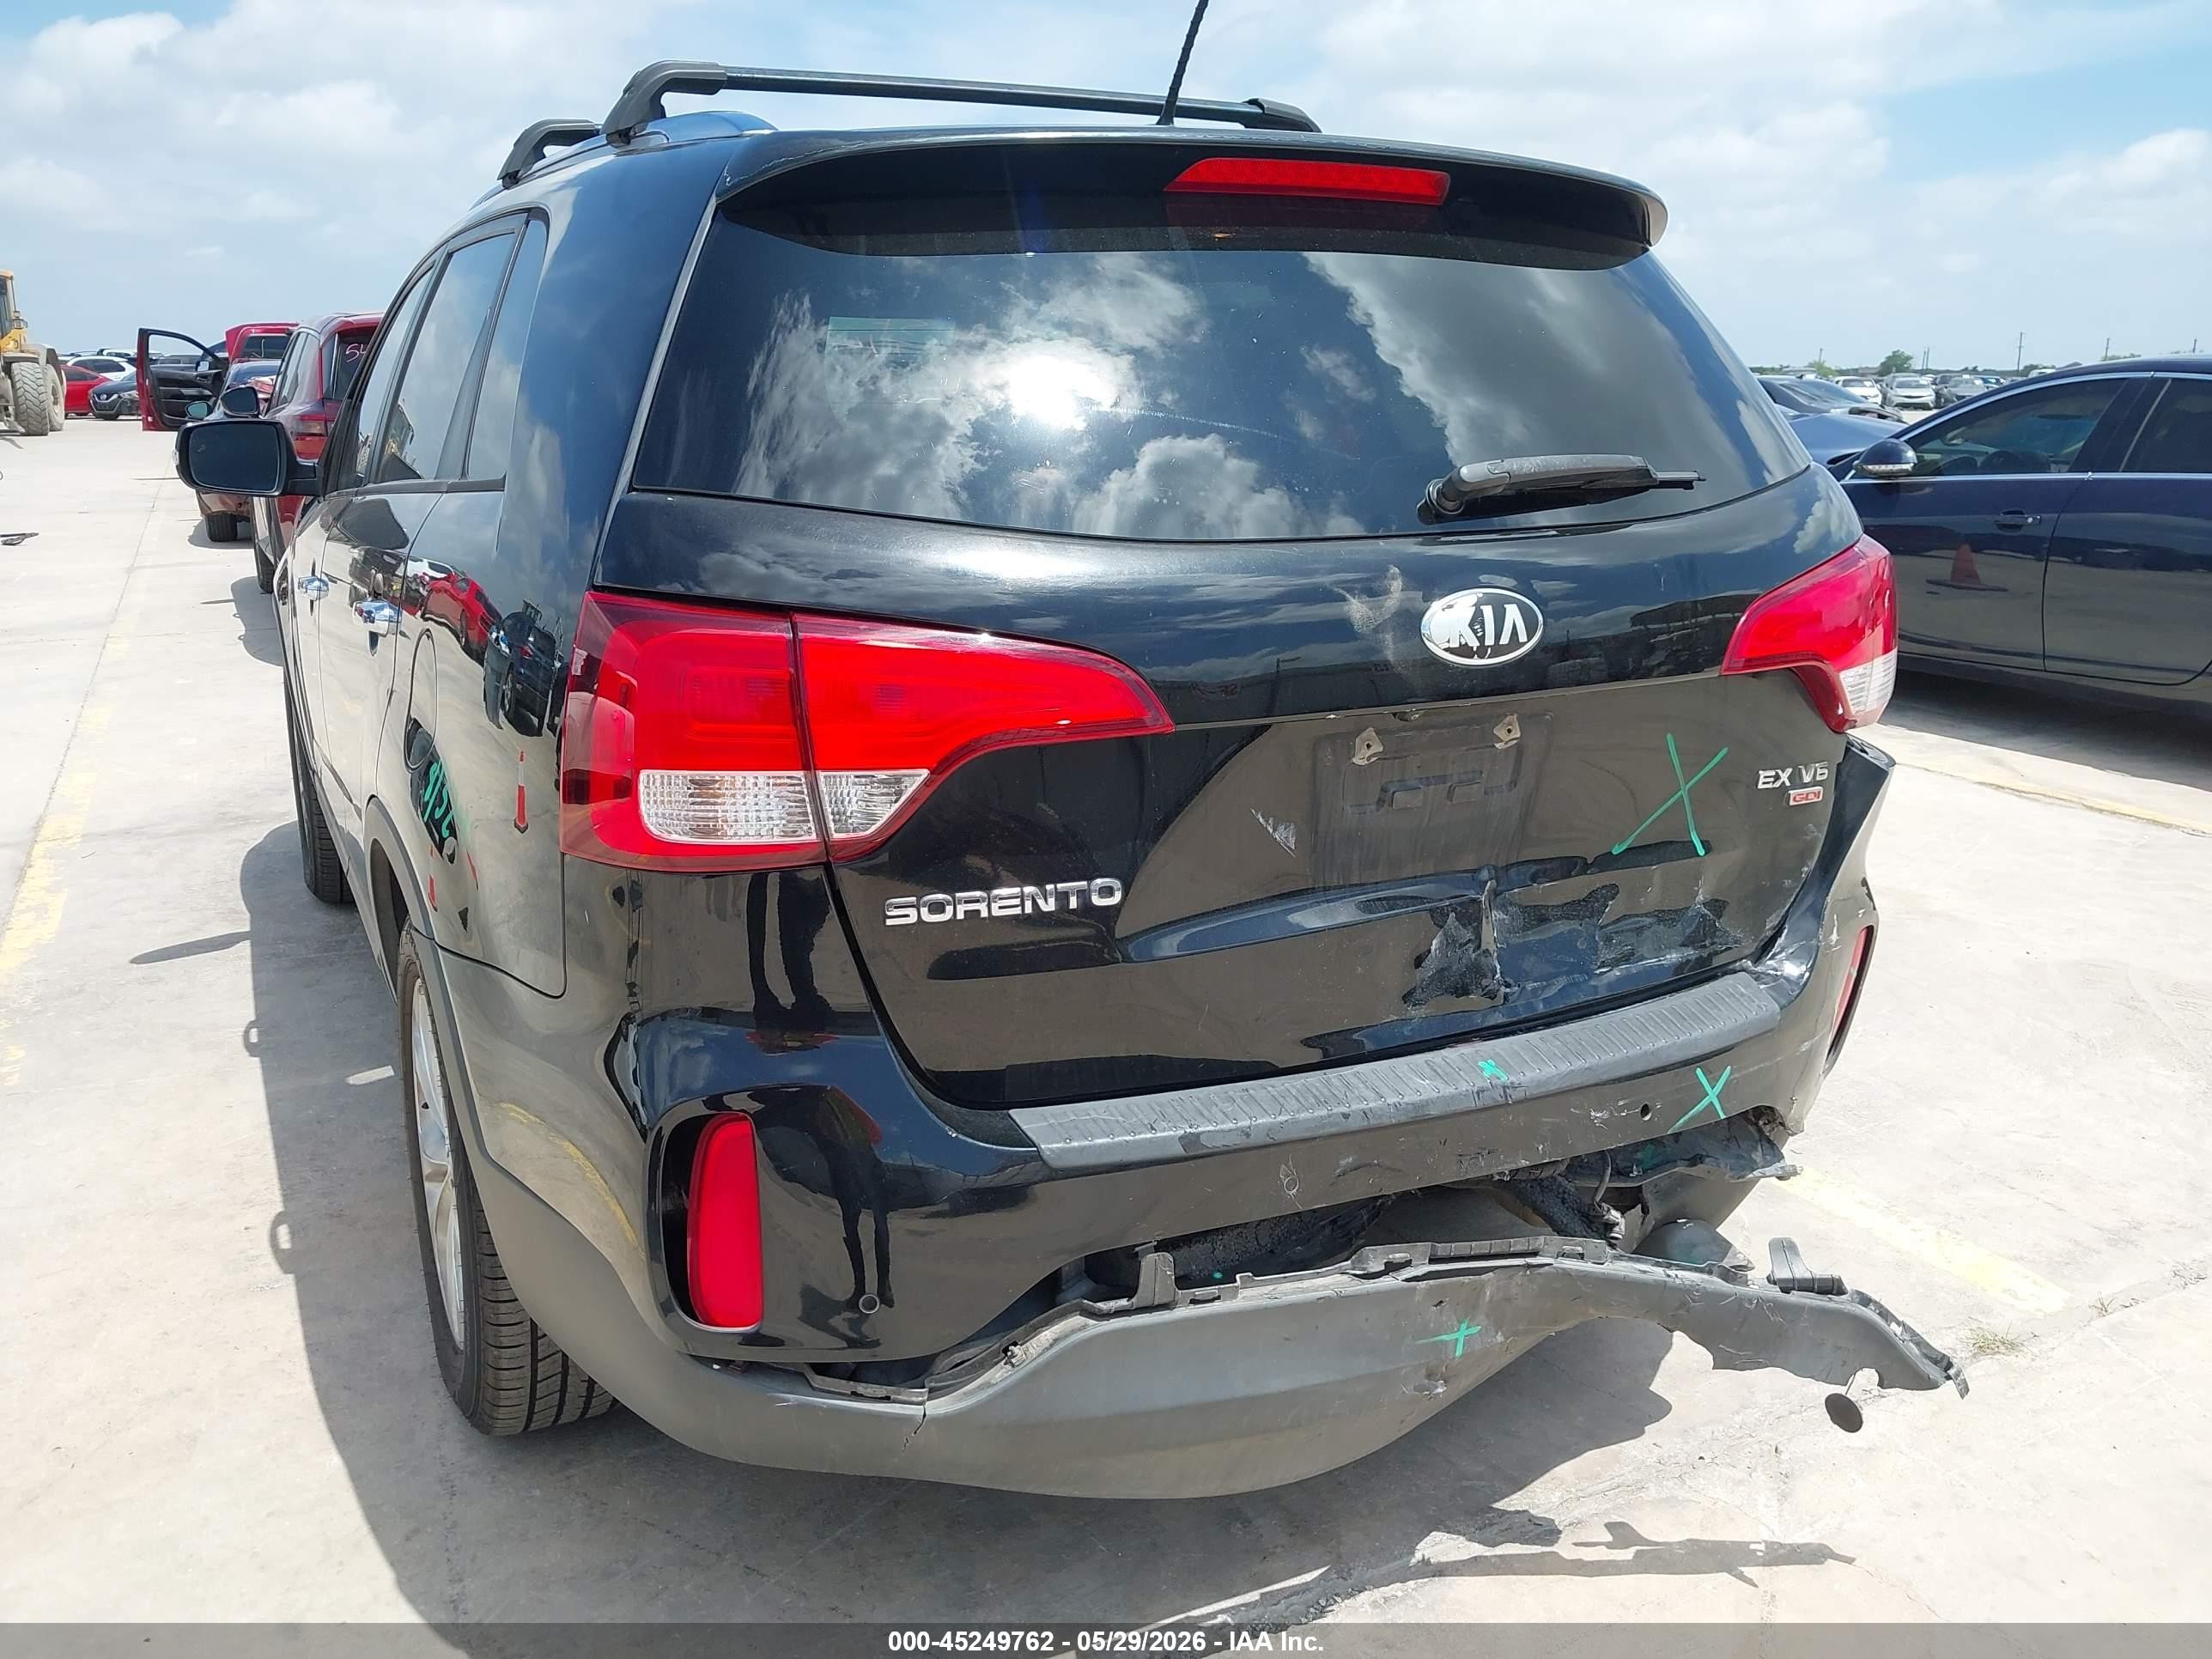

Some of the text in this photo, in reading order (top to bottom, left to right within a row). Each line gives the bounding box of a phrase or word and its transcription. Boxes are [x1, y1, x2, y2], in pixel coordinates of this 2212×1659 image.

[1449, 604, 1528, 648] KIA
[1757, 761, 1829, 789] EX V6
[1792, 791, 1821, 803] GDI
[885, 878, 1121, 926] SORENTO
